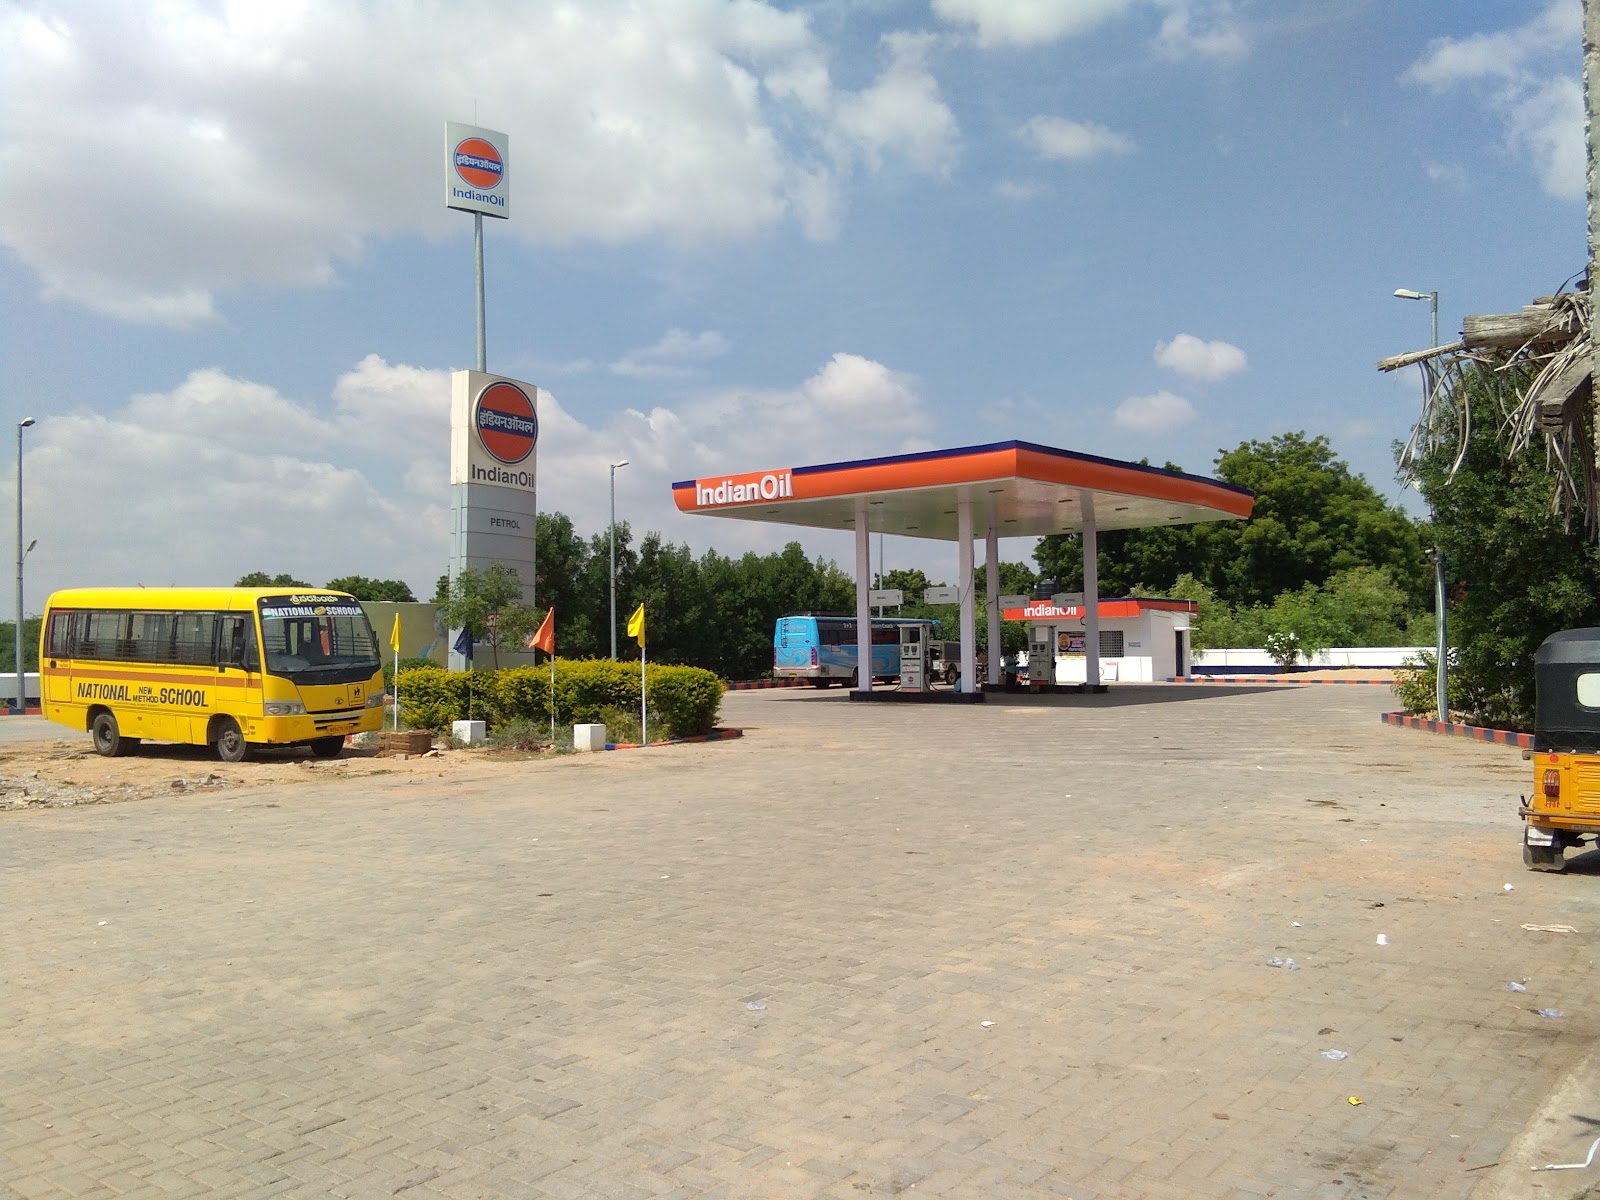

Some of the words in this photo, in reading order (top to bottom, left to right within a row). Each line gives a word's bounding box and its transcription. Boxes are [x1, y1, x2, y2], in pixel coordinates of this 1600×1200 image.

[456, 154, 501, 172] इंडियनऑयल
[453, 187, 504, 207] IndianOil
[479, 410, 534, 434] इंडियनऑयल
[472, 464, 535, 489] IndianOil
[696, 473, 793, 506] IndianOil
[490, 517, 521, 530] PETROL
[271, 606, 315, 617] NATIONAL
[326, 606, 358, 617] SCHOOL
[1023, 604, 1077, 617] IndianOil
[77, 682, 131, 702] NATIONAL
[132, 695, 159, 704] METHOD
[138, 686, 152, 695] NEW
[160, 687, 209, 708] SCHOOL
